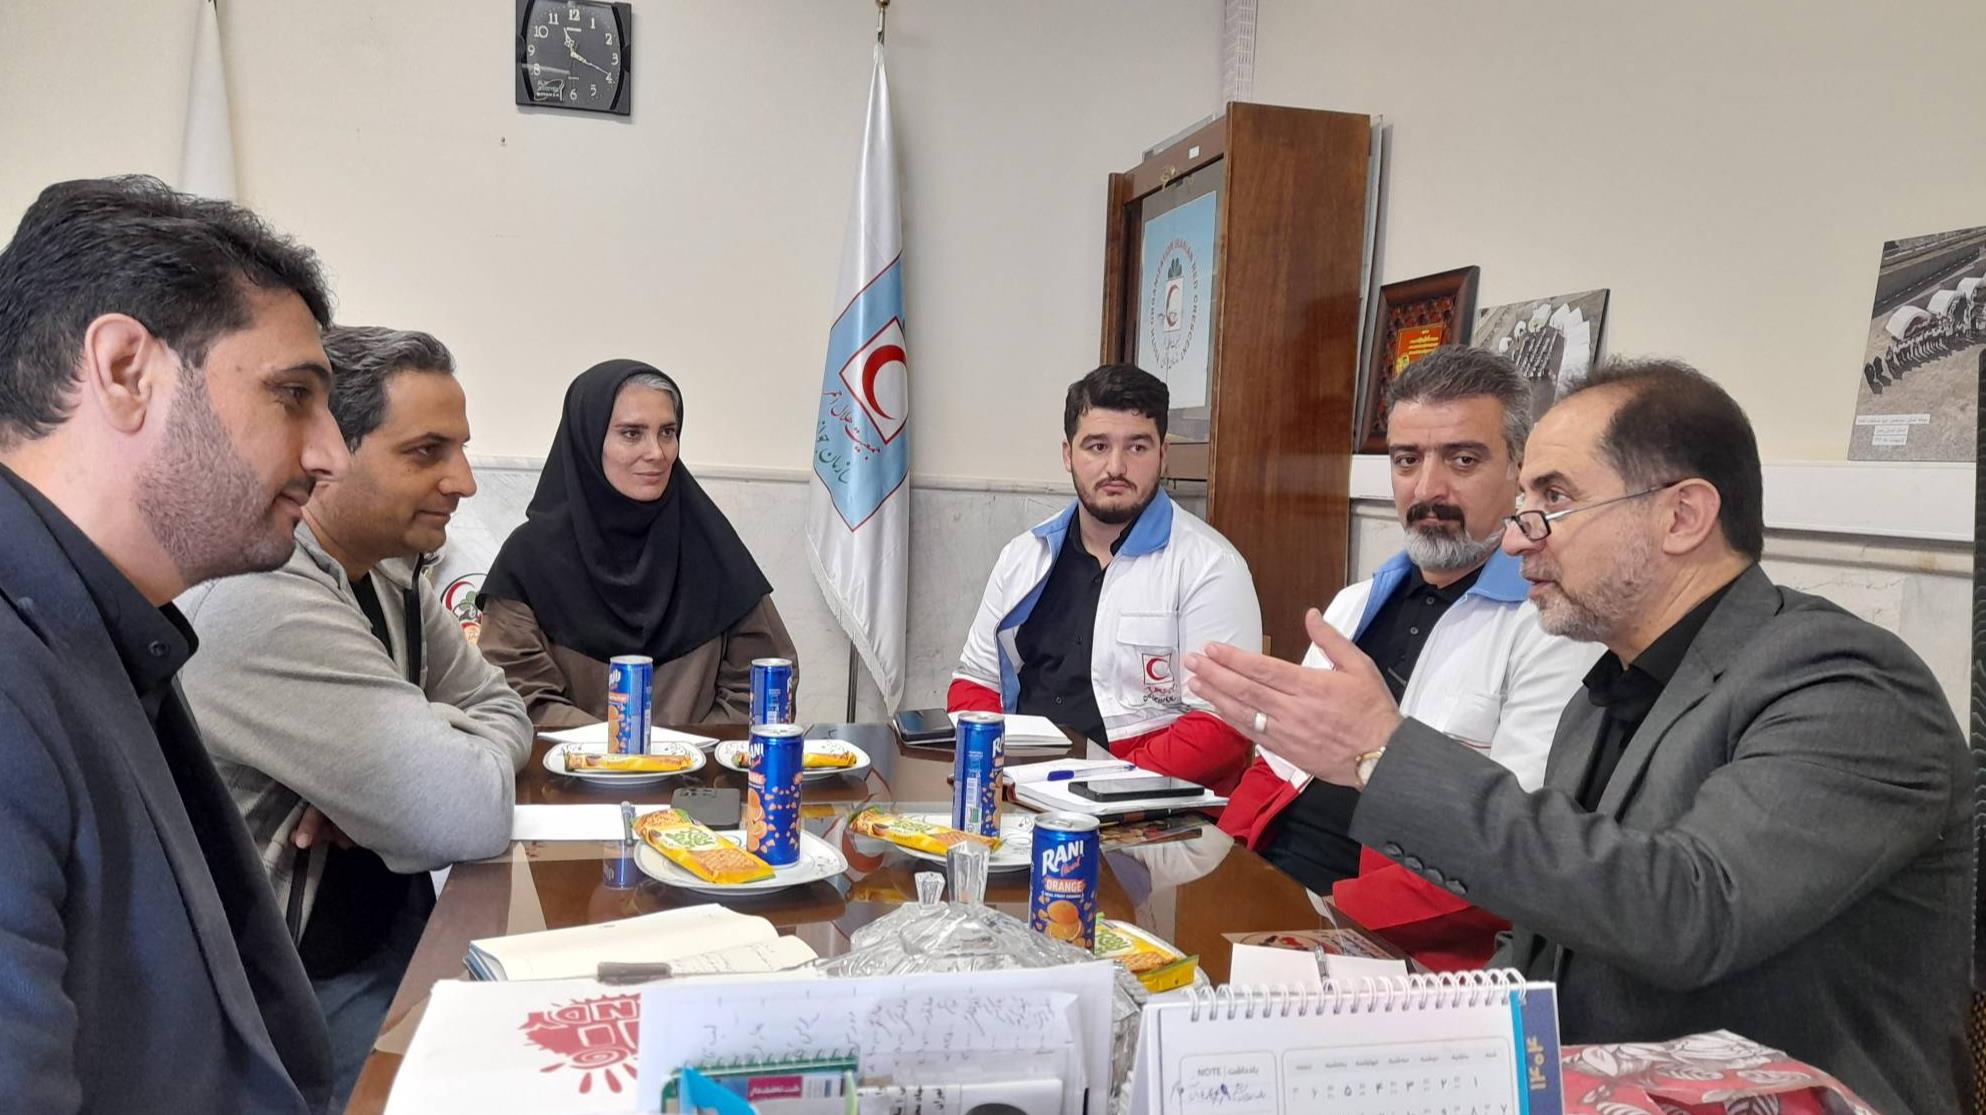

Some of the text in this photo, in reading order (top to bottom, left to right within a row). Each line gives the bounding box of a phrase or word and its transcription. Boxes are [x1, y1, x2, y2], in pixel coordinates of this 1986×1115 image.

[548, 12, 559, 25] 11
[568, 9, 580, 21] 12
[590, 17, 596, 30] 1
[534, 25, 549, 38] 10
[605, 33, 613, 46] 2
[527, 44, 536, 56] 9
[611, 53, 619, 66] 3
[605, 72, 613, 84] 4
[569, 89, 578, 100] 6
[590, 84, 597, 97] 5
[1042, 840, 1085, 876] RANI
[1046, 879, 1083, 893] ORANGE
[1197, 1066, 1222, 1077] NOTE
